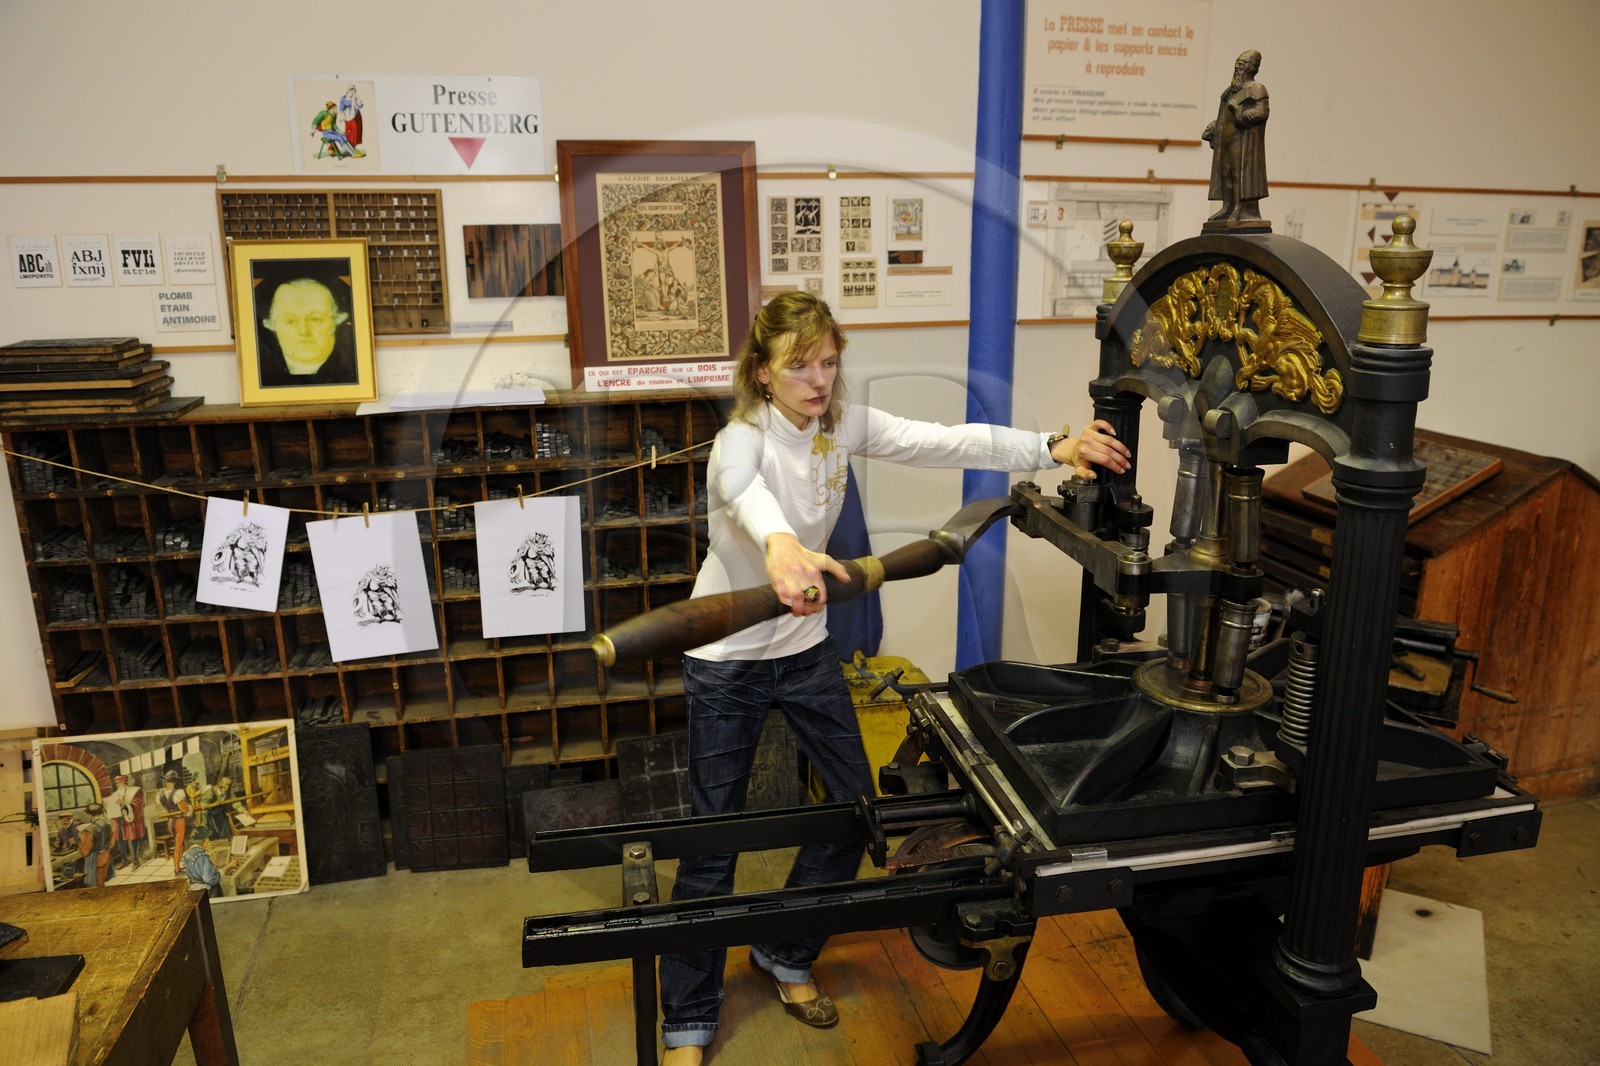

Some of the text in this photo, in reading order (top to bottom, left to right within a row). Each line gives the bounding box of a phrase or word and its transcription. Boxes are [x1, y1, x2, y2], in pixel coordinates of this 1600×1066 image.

[1060, 15, 1104, 34] PRESSE
[1108, 22, 1127, 36] met
[1131, 25, 1144, 36] en
[1148, 24, 1181, 39] contact
[1186, 25, 1195, 39] le
[1048, 37, 1189, 58] papier & les supports encrés
[1085, 60, 1146, 78] à reproduire
[432, 84, 497, 106] Presse
[391, 112, 539, 134] GUTENBERG
[1057, 207, 1065, 221] 3
[72, 249, 103, 262] ABJ
[158, 292, 193, 301] PLOMB
[160, 304, 190, 312] ETAIN
[162, 315, 217, 326] ANTIMOINE
[697, 364, 717, 372] BOIS
[597, 379, 632, 387] L'ENCRE
[688, 374, 730, 383] L'IMPRIME
